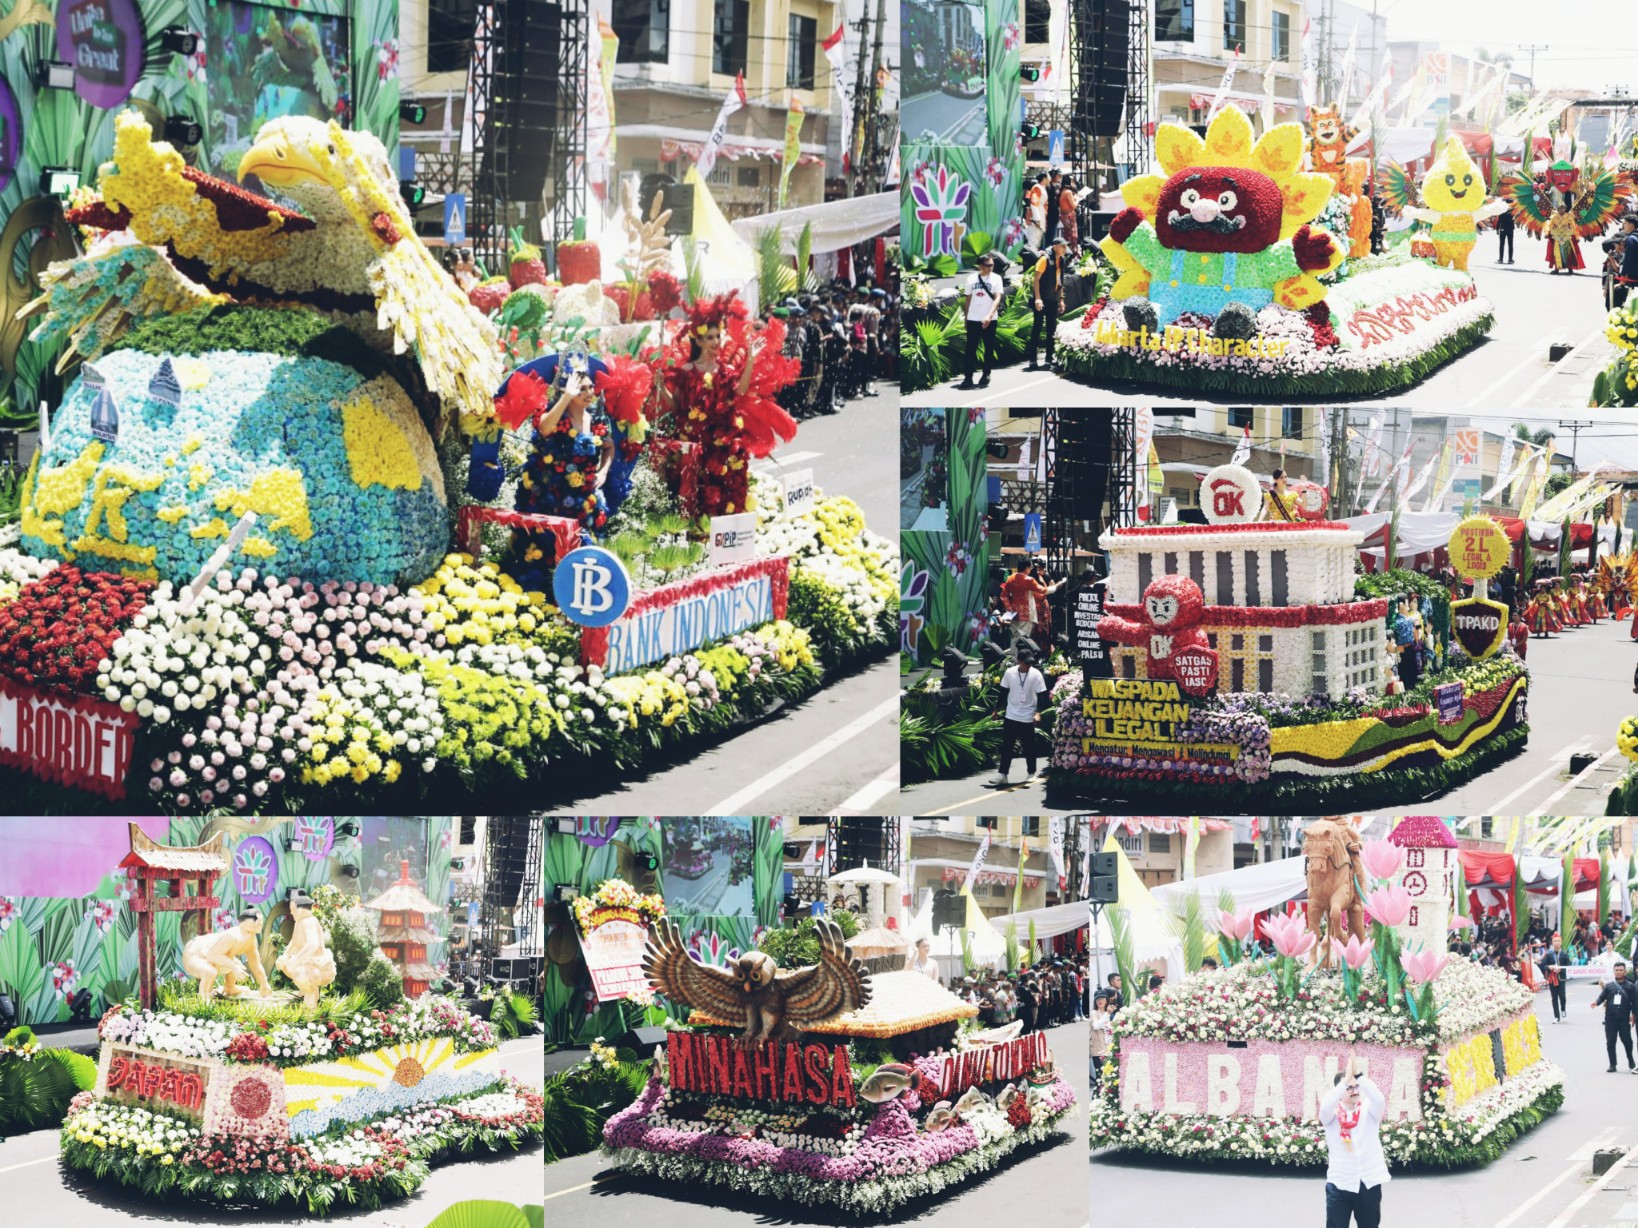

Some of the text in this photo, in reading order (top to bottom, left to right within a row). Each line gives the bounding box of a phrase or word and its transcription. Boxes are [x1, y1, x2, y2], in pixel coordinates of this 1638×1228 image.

[1164, 325, 1184, 351] IP
[1187, 327, 1290, 358] Character
[1460, 528, 1495, 537] PASTIKAN
[1465, 537, 1489, 553] 2 L
[1462, 552, 1485, 561] LEGAL
[1077, 602, 1100, 612] ONLINE
[605, 575, 775, 678] BANK INDONESIA
[1456, 615, 1499, 631] TPAKD
[1077, 640, 1101, 650] ONLINE
[1175, 655, 1212, 666] SATGAS
[1181, 666, 1210, 677] PASTI
[1090, 679, 1181, 701] WASPADA
[1082, 698, 1189, 723] KEUANGAN
[17, 699, 134, 785] BORDER
[668, 1031, 857, 1108] MINAHASA
[106, 1056, 203, 1111] JAPAN
